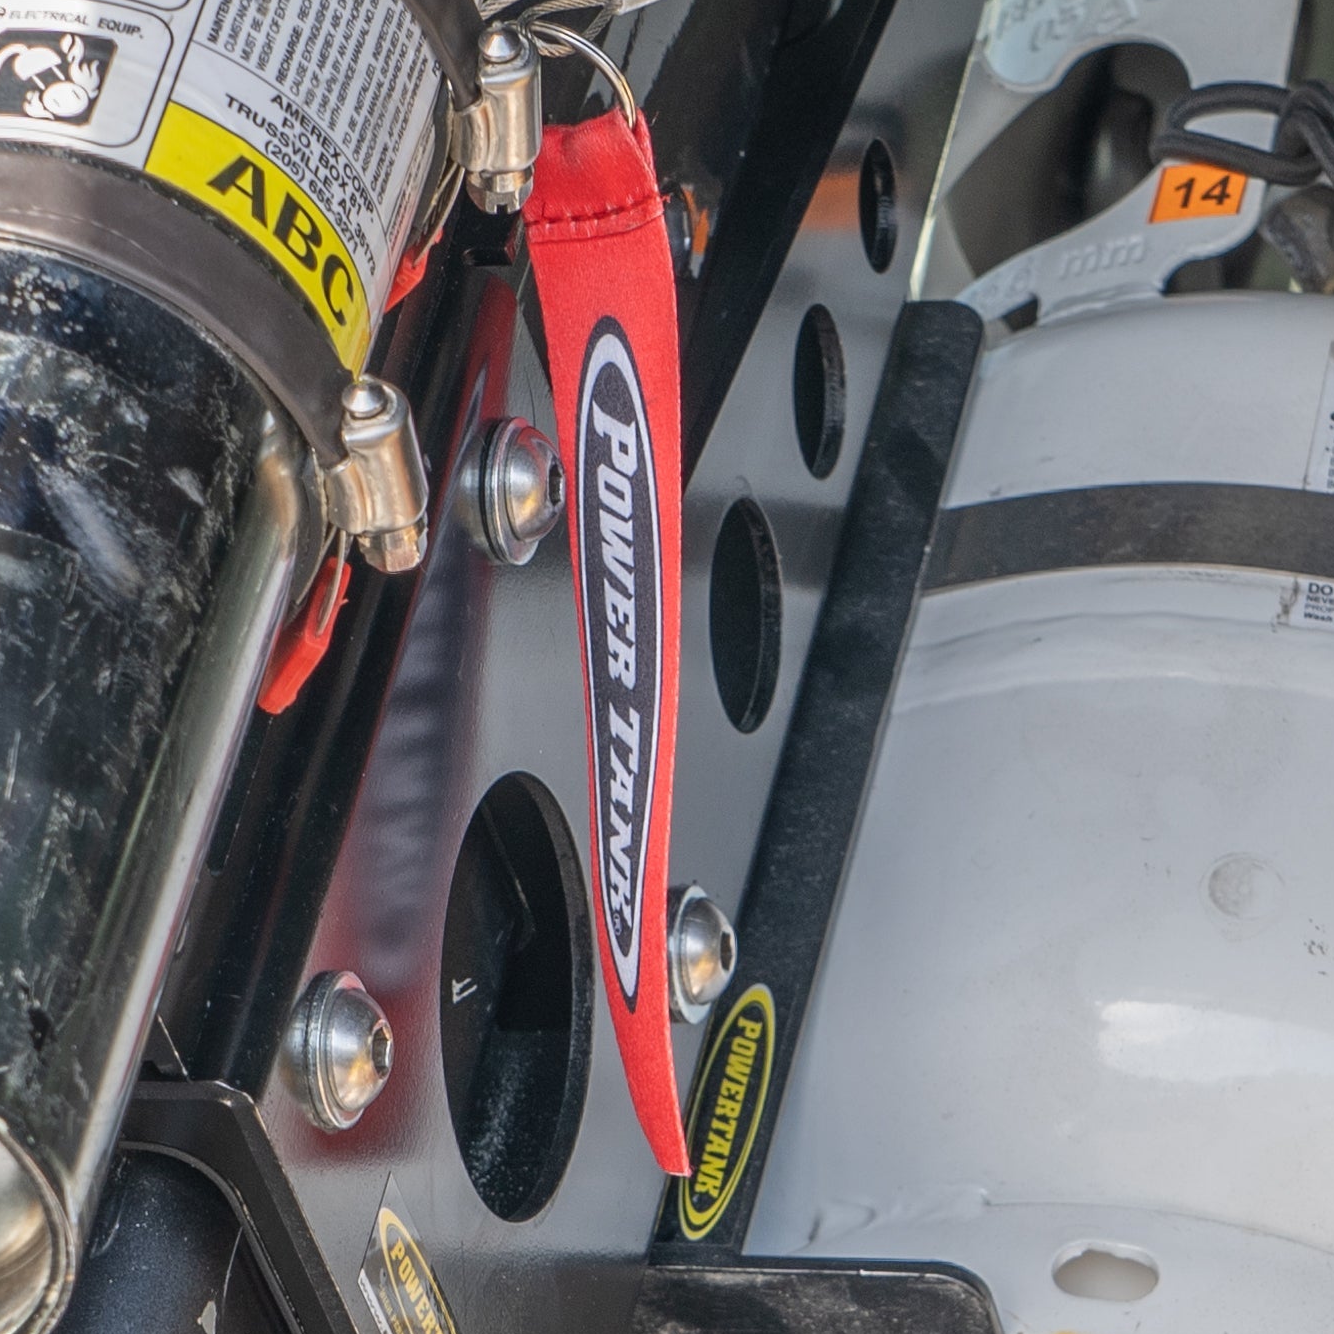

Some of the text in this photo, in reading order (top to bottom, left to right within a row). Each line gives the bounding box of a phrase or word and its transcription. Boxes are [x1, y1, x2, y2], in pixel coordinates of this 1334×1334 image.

[96, 17, 145, 40] EQUIP.
[239, 32, 258, 62] MUST
[249, 15, 264, 33] BE
[255, 33, 277, 71] WEIGHT
[268, 17, 282, 35] OF
[313, 29, 336, 73] AMEREX
[328, 7, 344, 31] ABC
[288, 62, 308, 96] CAUSE
[336, 63, 356, 106] SERVICE
[270, 96, 338, 164] AMEREX
[265, 141, 304, 182] (205)
[282, 116, 362, 215] P.O. BOX 81
[336, 199, 352, 225] AL
[1173, 174, 1232, 209] 14
[207, 153, 355, 328] ABC
[1307, 581, 1334, 597] DO
[591, 395, 643, 929] POWER TANK
[693, 1014, 763, 1199] POWERTANK
